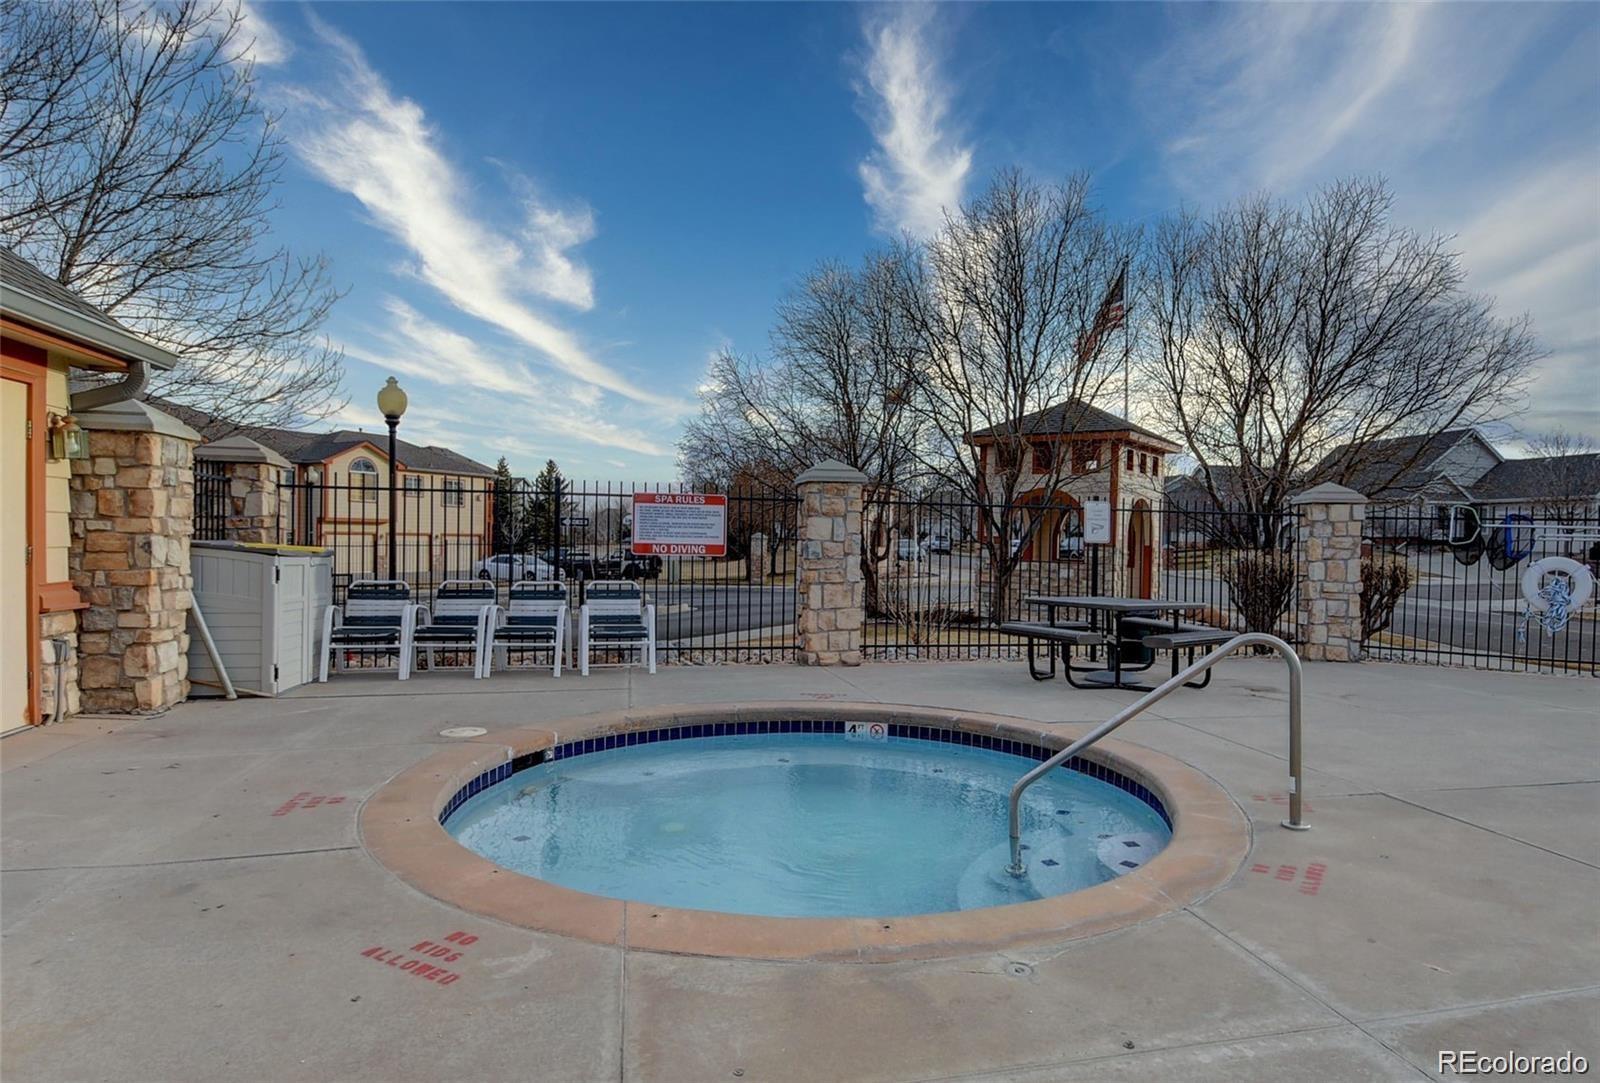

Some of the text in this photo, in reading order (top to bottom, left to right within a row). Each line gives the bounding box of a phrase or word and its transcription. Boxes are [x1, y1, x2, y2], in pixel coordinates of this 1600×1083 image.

[655, 495, 706, 504] SPA RULES
[652, 544, 706, 554] NO DIVING
[848, 724, 857, 733] 4
[444, 930, 479, 946] NO
[410, 941, 464, 962] KIDS
[360, 947, 460, 985] ALLOWED
